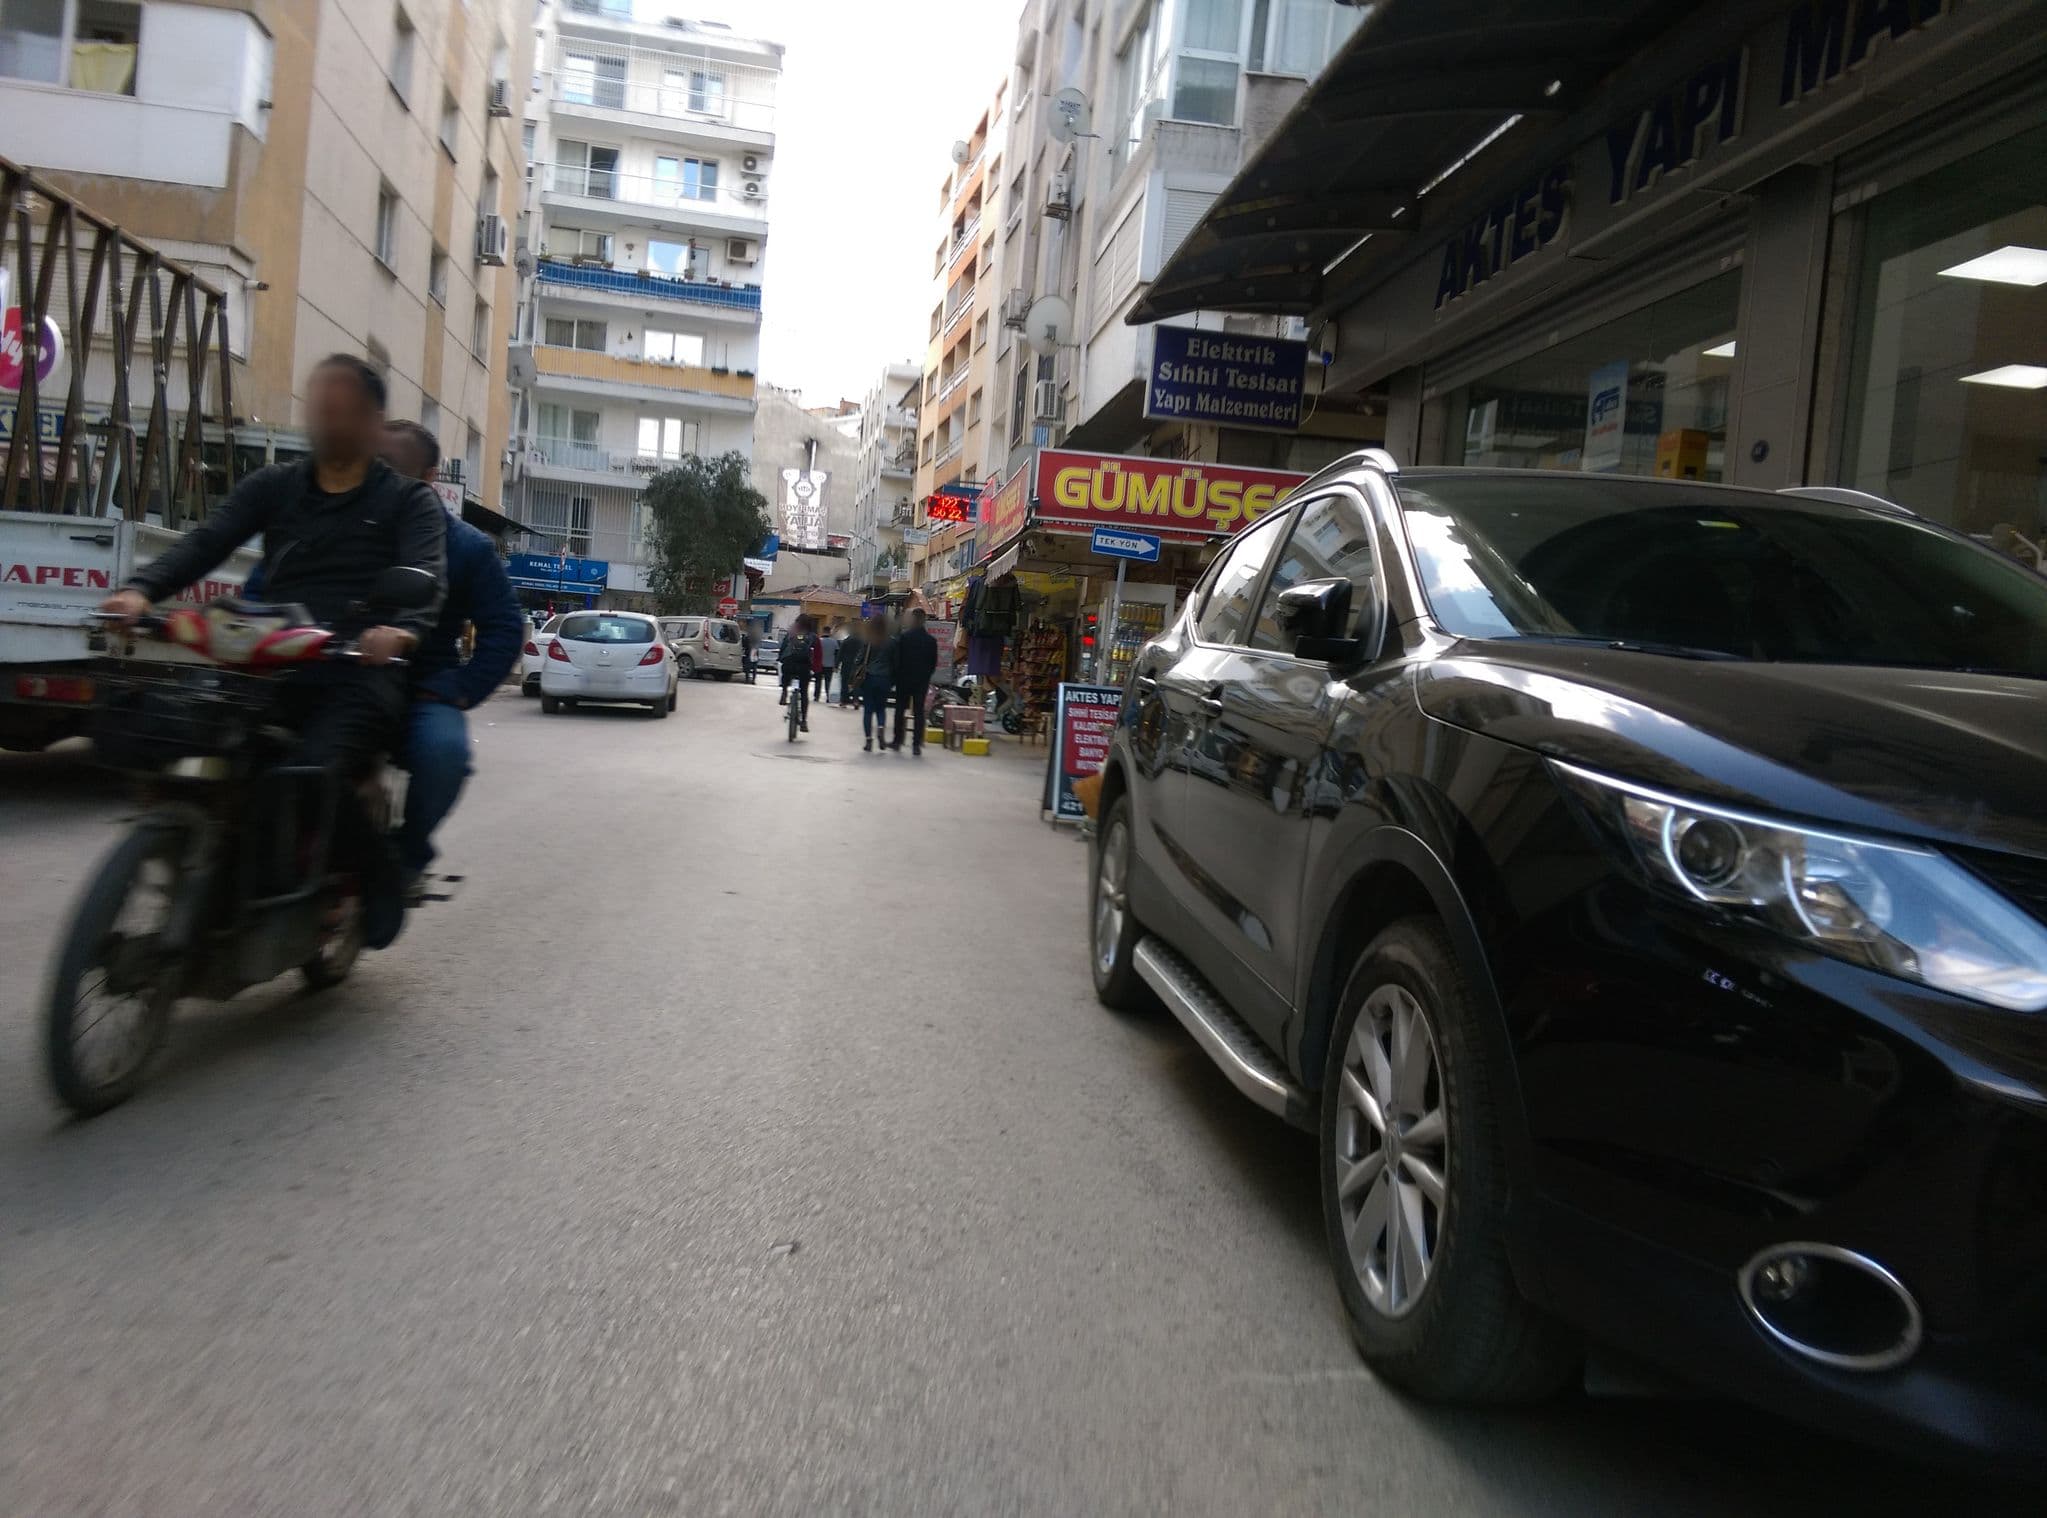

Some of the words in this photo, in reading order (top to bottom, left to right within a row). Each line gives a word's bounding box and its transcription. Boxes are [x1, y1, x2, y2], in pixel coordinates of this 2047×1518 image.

[1435, 158, 1577, 312] AKTES
[1605, 44, 1750, 210] YAPI
[1186, 336, 1278, 366] Elektrik
[1225, 367, 1298, 395] Tesisat
[1154, 387, 1192, 416] Yapı
[1196, 393, 1298, 422] Malzemeleri
[1097, 536, 1117, 547] TEK
[1119, 538, 1140, 550] YÖN
[1064, 690, 1098, 704] AKTES
